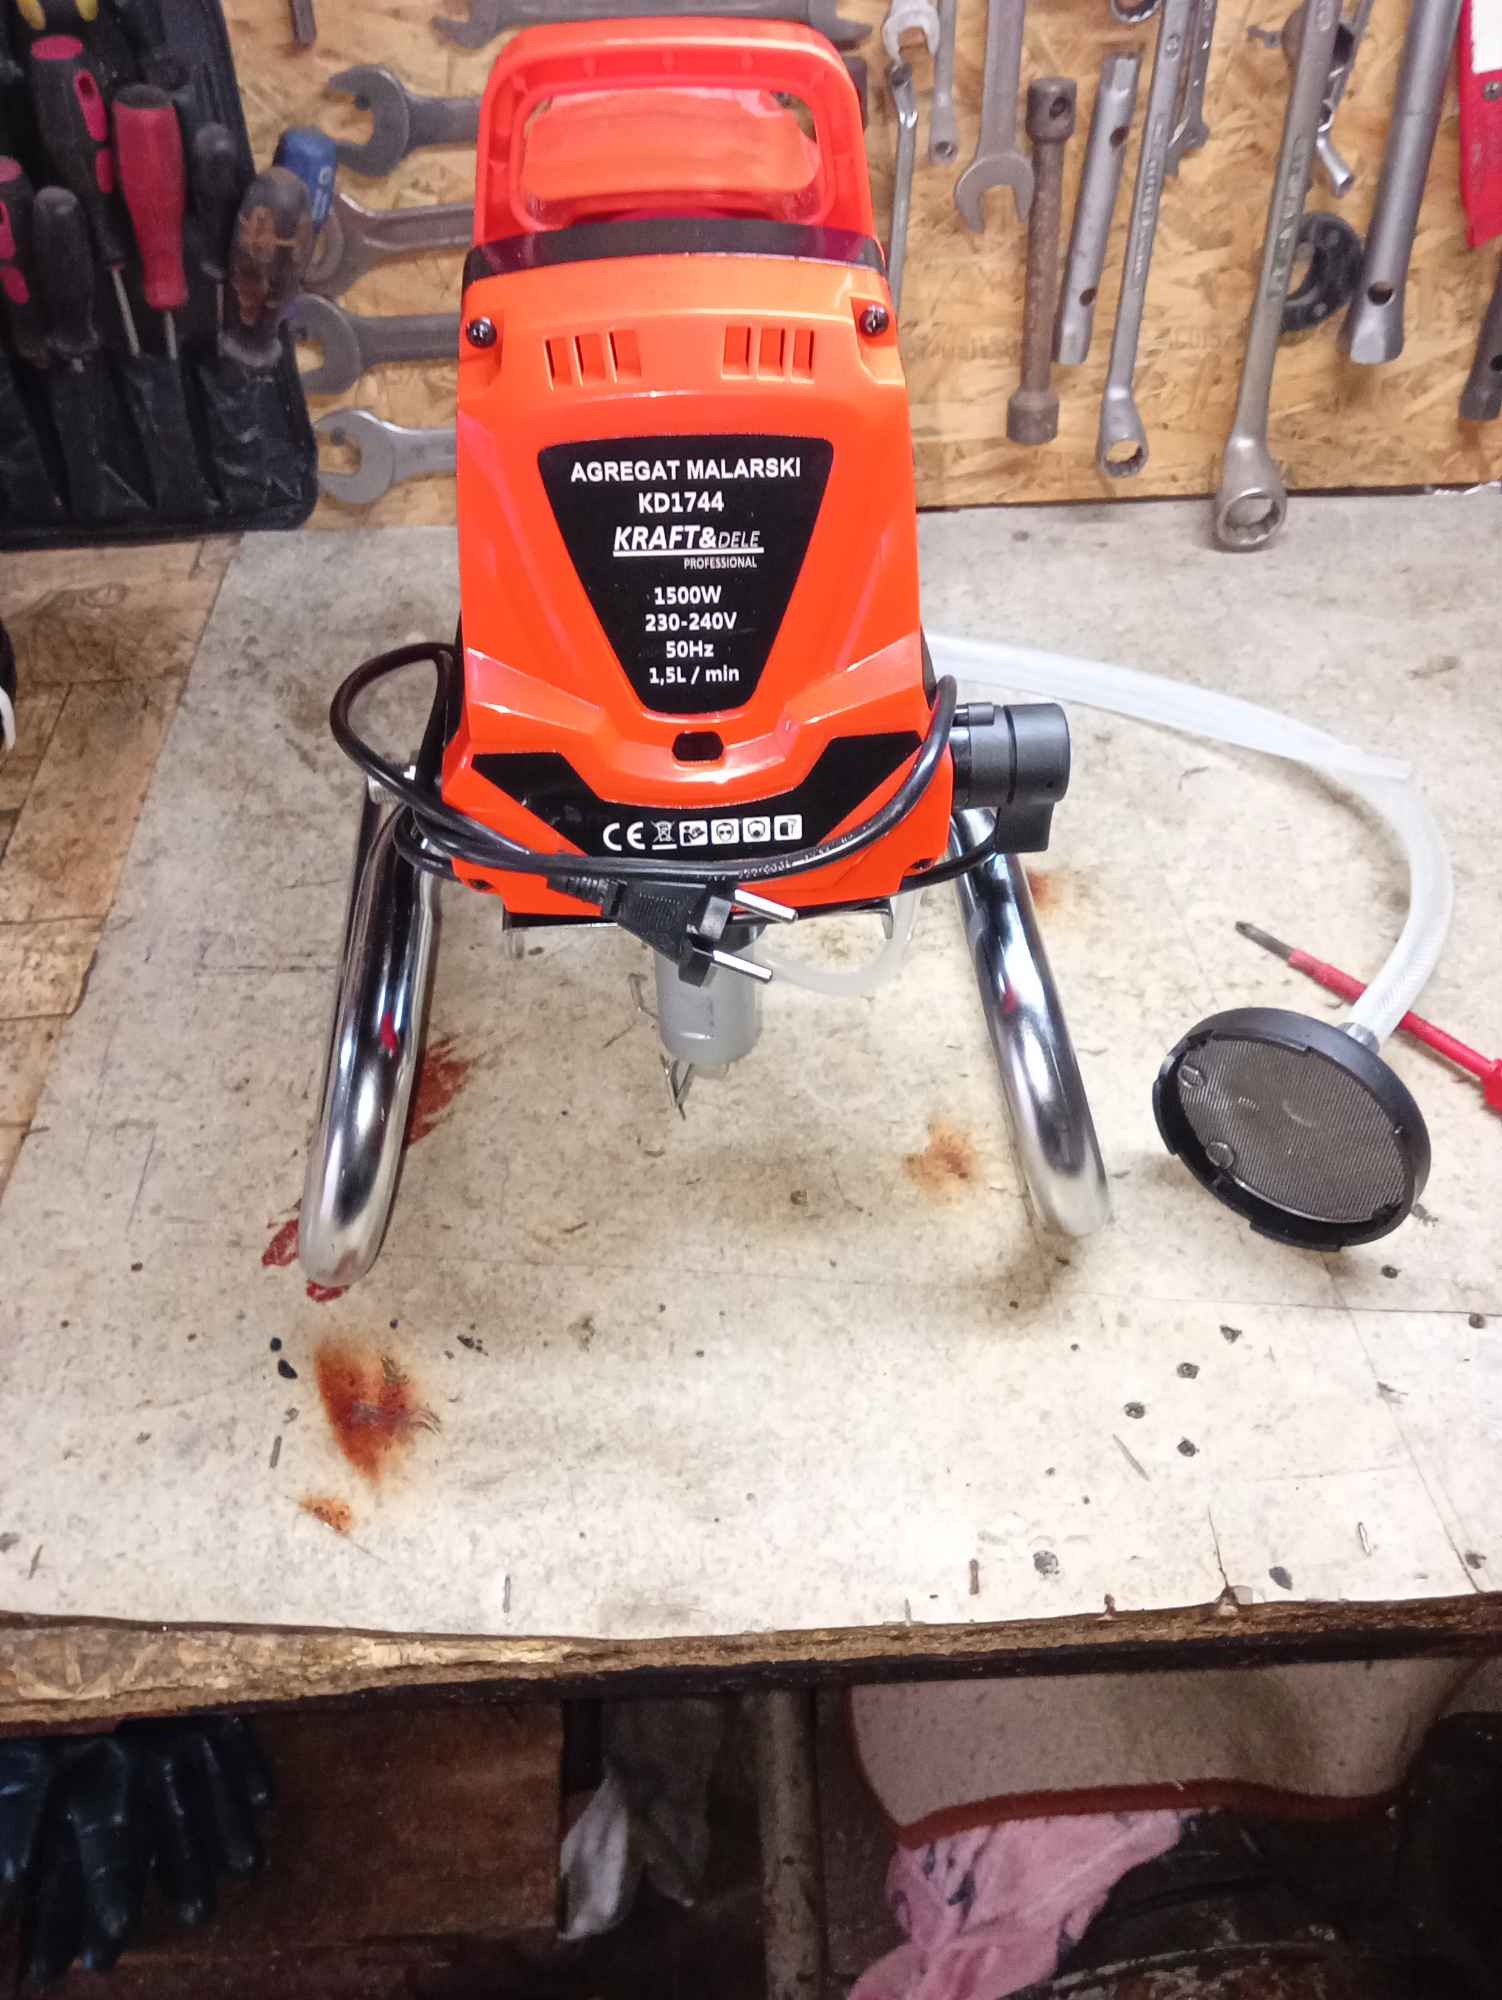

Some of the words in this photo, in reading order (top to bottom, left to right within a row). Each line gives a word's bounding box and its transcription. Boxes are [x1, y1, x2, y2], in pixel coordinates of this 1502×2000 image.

[570, 459, 680, 482] AGREGAT
[686, 457, 800, 479] MALARSKI
[638, 491, 725, 514] KD1744
[683, 555, 758, 570] PROFESSIONAL
[654, 585, 722, 606] 1500W
[645, 611, 738, 632] 230-240V
[665, 640, 715, 659] 50Hz
[649, 666, 687, 687] 1,5L
[690, 665, 701, 685] /
[705, 664, 740, 683] min
